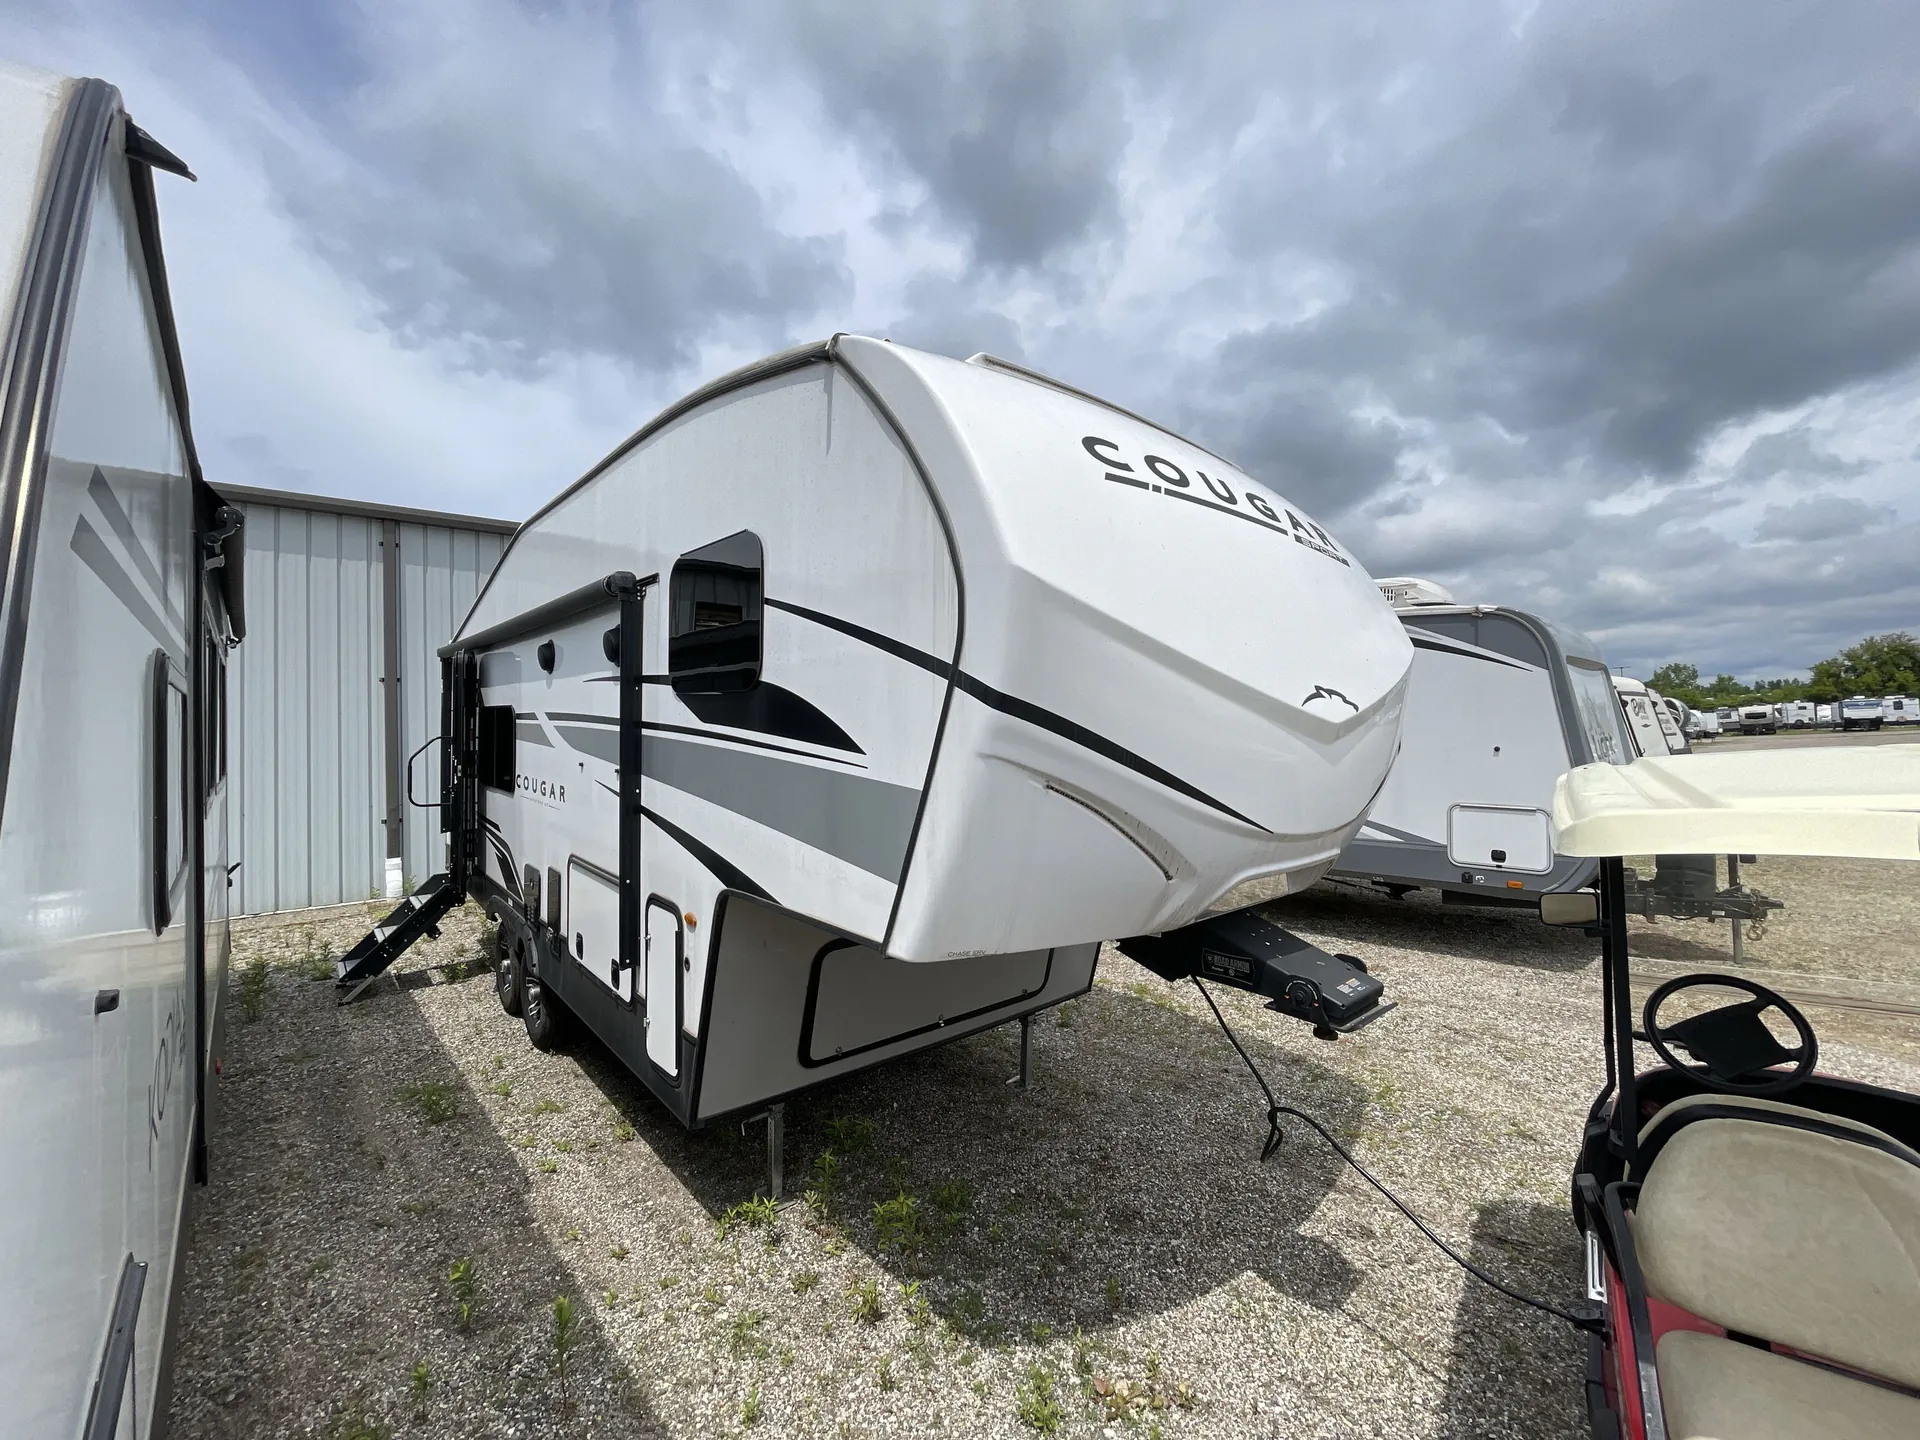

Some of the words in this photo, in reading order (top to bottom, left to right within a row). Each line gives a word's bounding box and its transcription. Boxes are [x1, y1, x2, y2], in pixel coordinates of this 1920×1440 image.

[1081, 436, 1339, 552] COUGAR
[1300, 537, 1343, 563] SPORT
[516, 774, 566, 803] COUGAR
